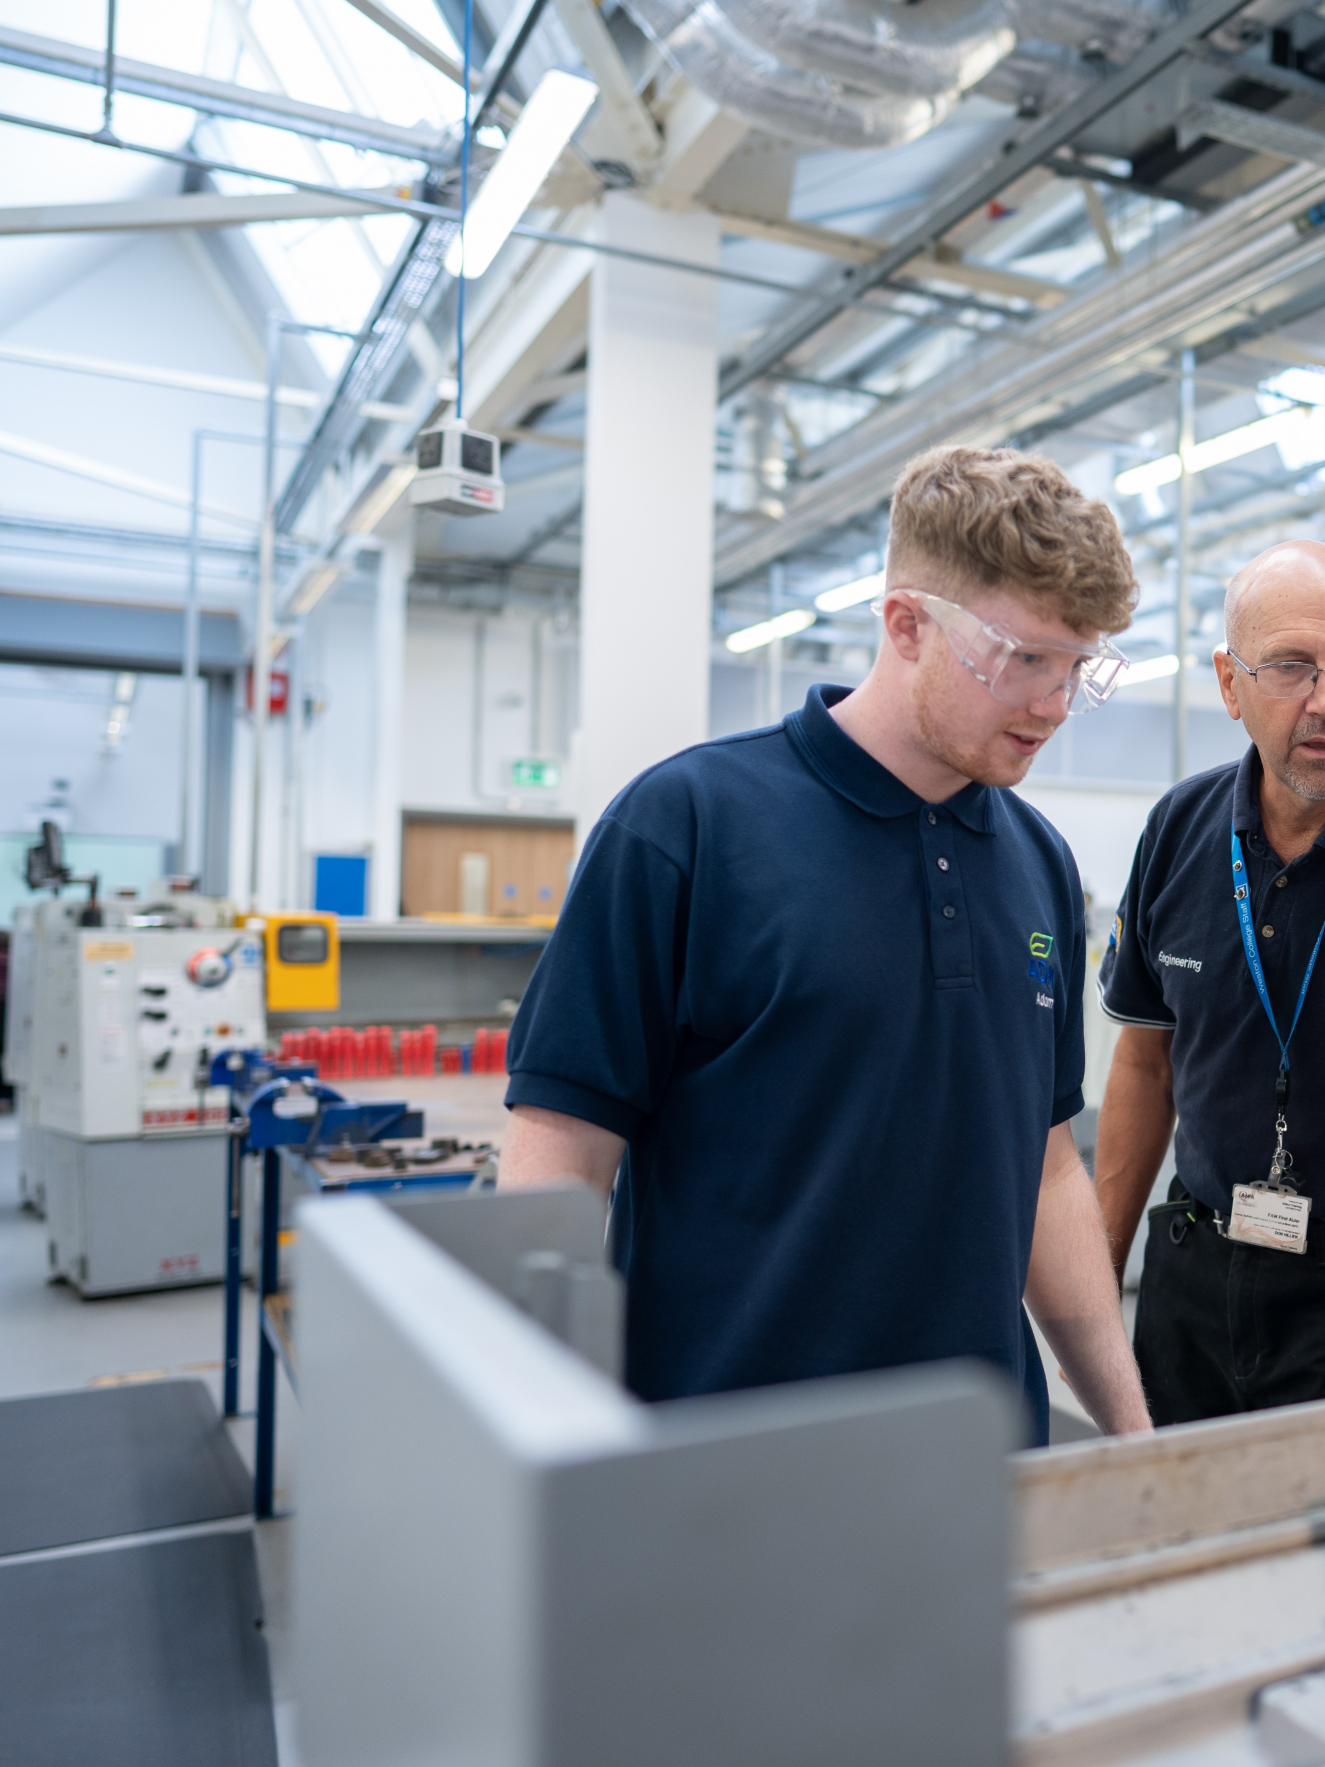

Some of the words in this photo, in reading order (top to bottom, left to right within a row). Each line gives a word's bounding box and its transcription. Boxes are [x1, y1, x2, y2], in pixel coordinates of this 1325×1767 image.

[1240, 902, 1249, 923] Staff
[1245, 924, 1256, 958] College
[1158, 950, 1202, 973] Engineering
[1253, 959, 1265, 994] Weston
